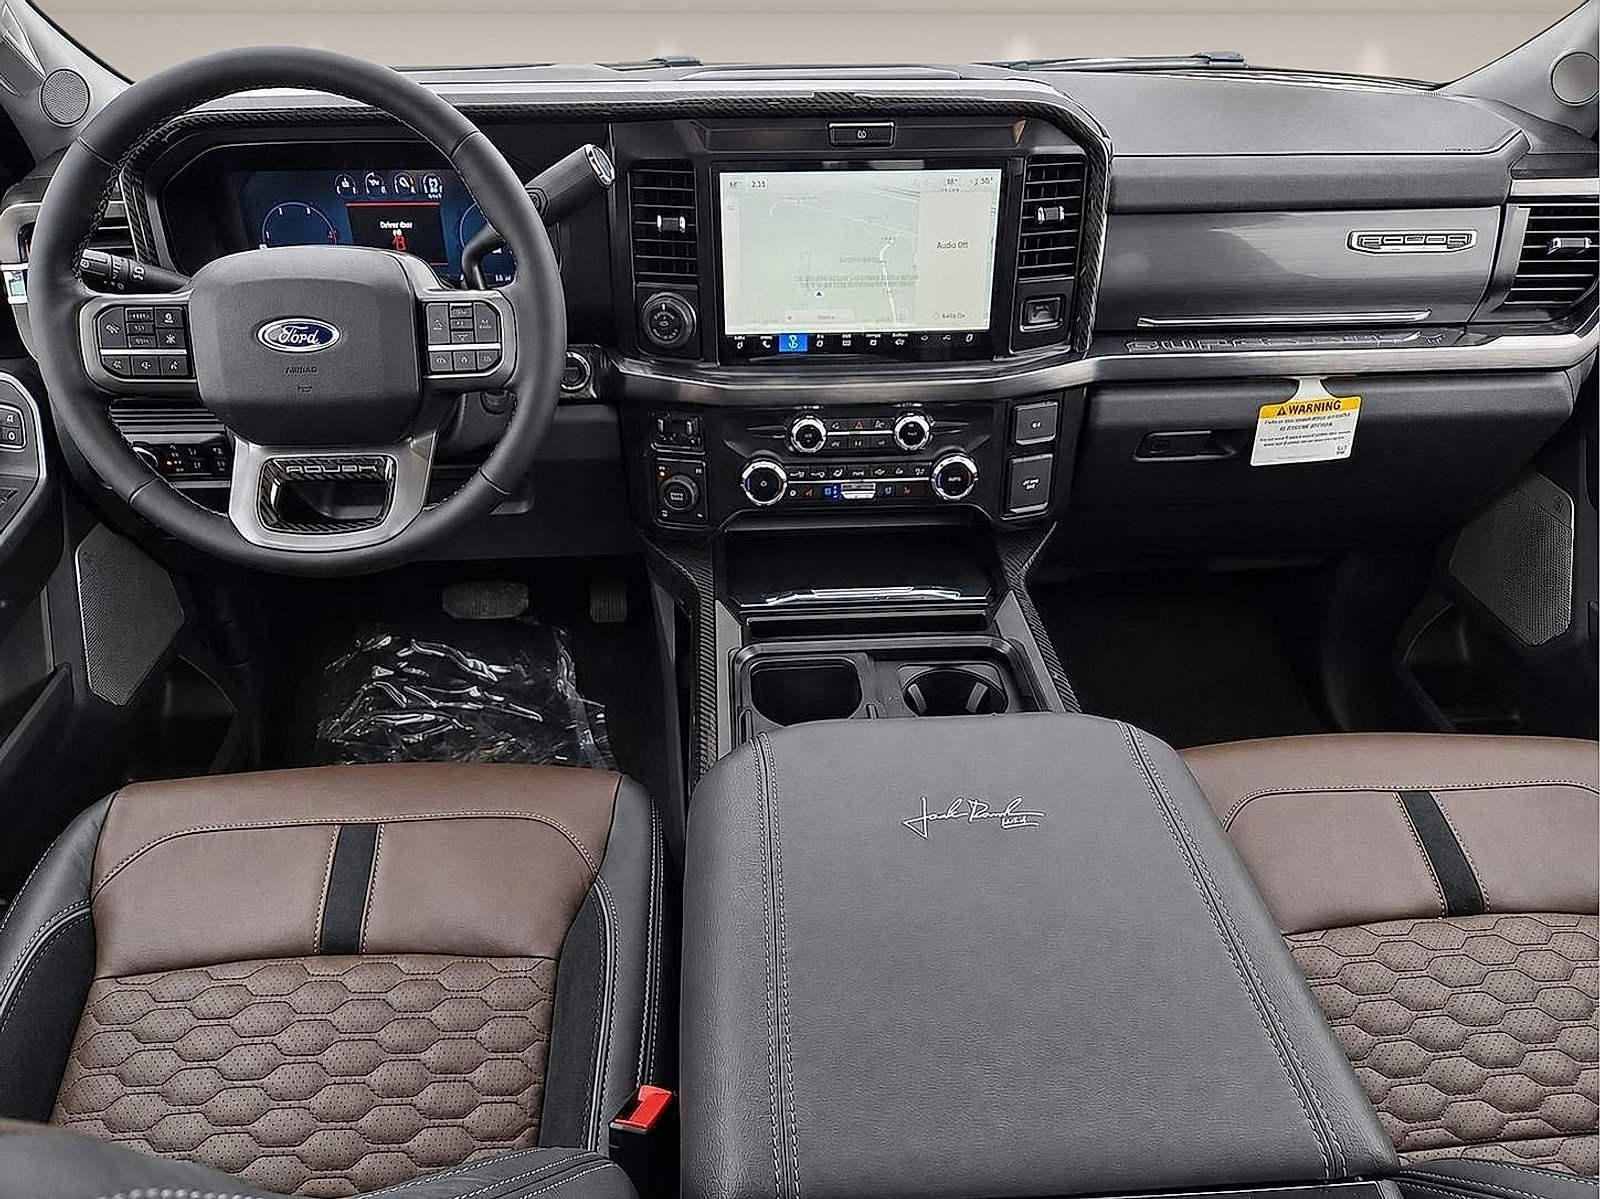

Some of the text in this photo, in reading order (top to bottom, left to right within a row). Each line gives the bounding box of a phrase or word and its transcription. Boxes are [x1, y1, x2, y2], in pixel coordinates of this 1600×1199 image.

[936, 241, 970, 250] Audio Off
[279, 325, 320, 345] Ford
[1288, 399, 1341, 415] WARNING
